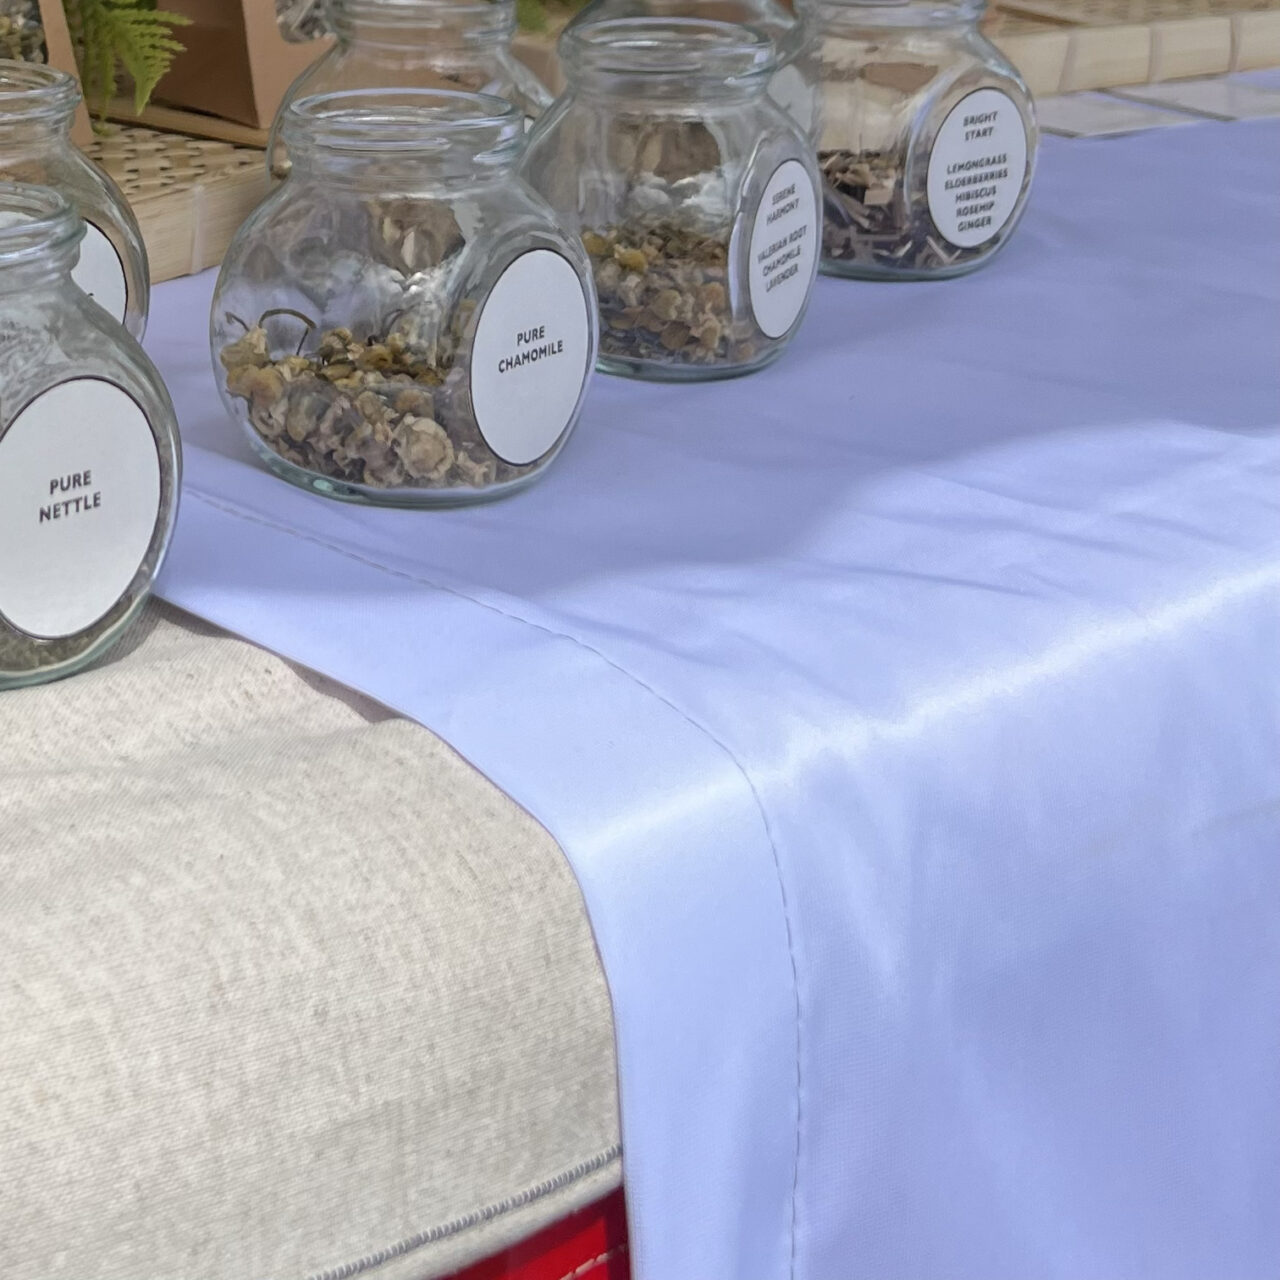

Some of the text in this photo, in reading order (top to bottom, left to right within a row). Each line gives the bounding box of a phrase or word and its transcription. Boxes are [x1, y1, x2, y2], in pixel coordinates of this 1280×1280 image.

[963, 111, 999, 127] BRIGHT
[965, 126, 994, 141] START
[947, 153, 1007, 175] LEMONGRASS
[945, 168, 1008, 190] ELDERBERRIES
[955, 185, 997, 204] HIBISCUS
[956, 201, 995, 218] ROSEHIP
[958, 215, 991, 232] GINGER
[762, 244, 801, 277] CHAMOMILE
[517, 325, 545, 346] PURE
[498, 340, 563, 373] CHAMOMILE
[50, 470, 91, 495] PURE
[40, 491, 101, 523] NETTLE
